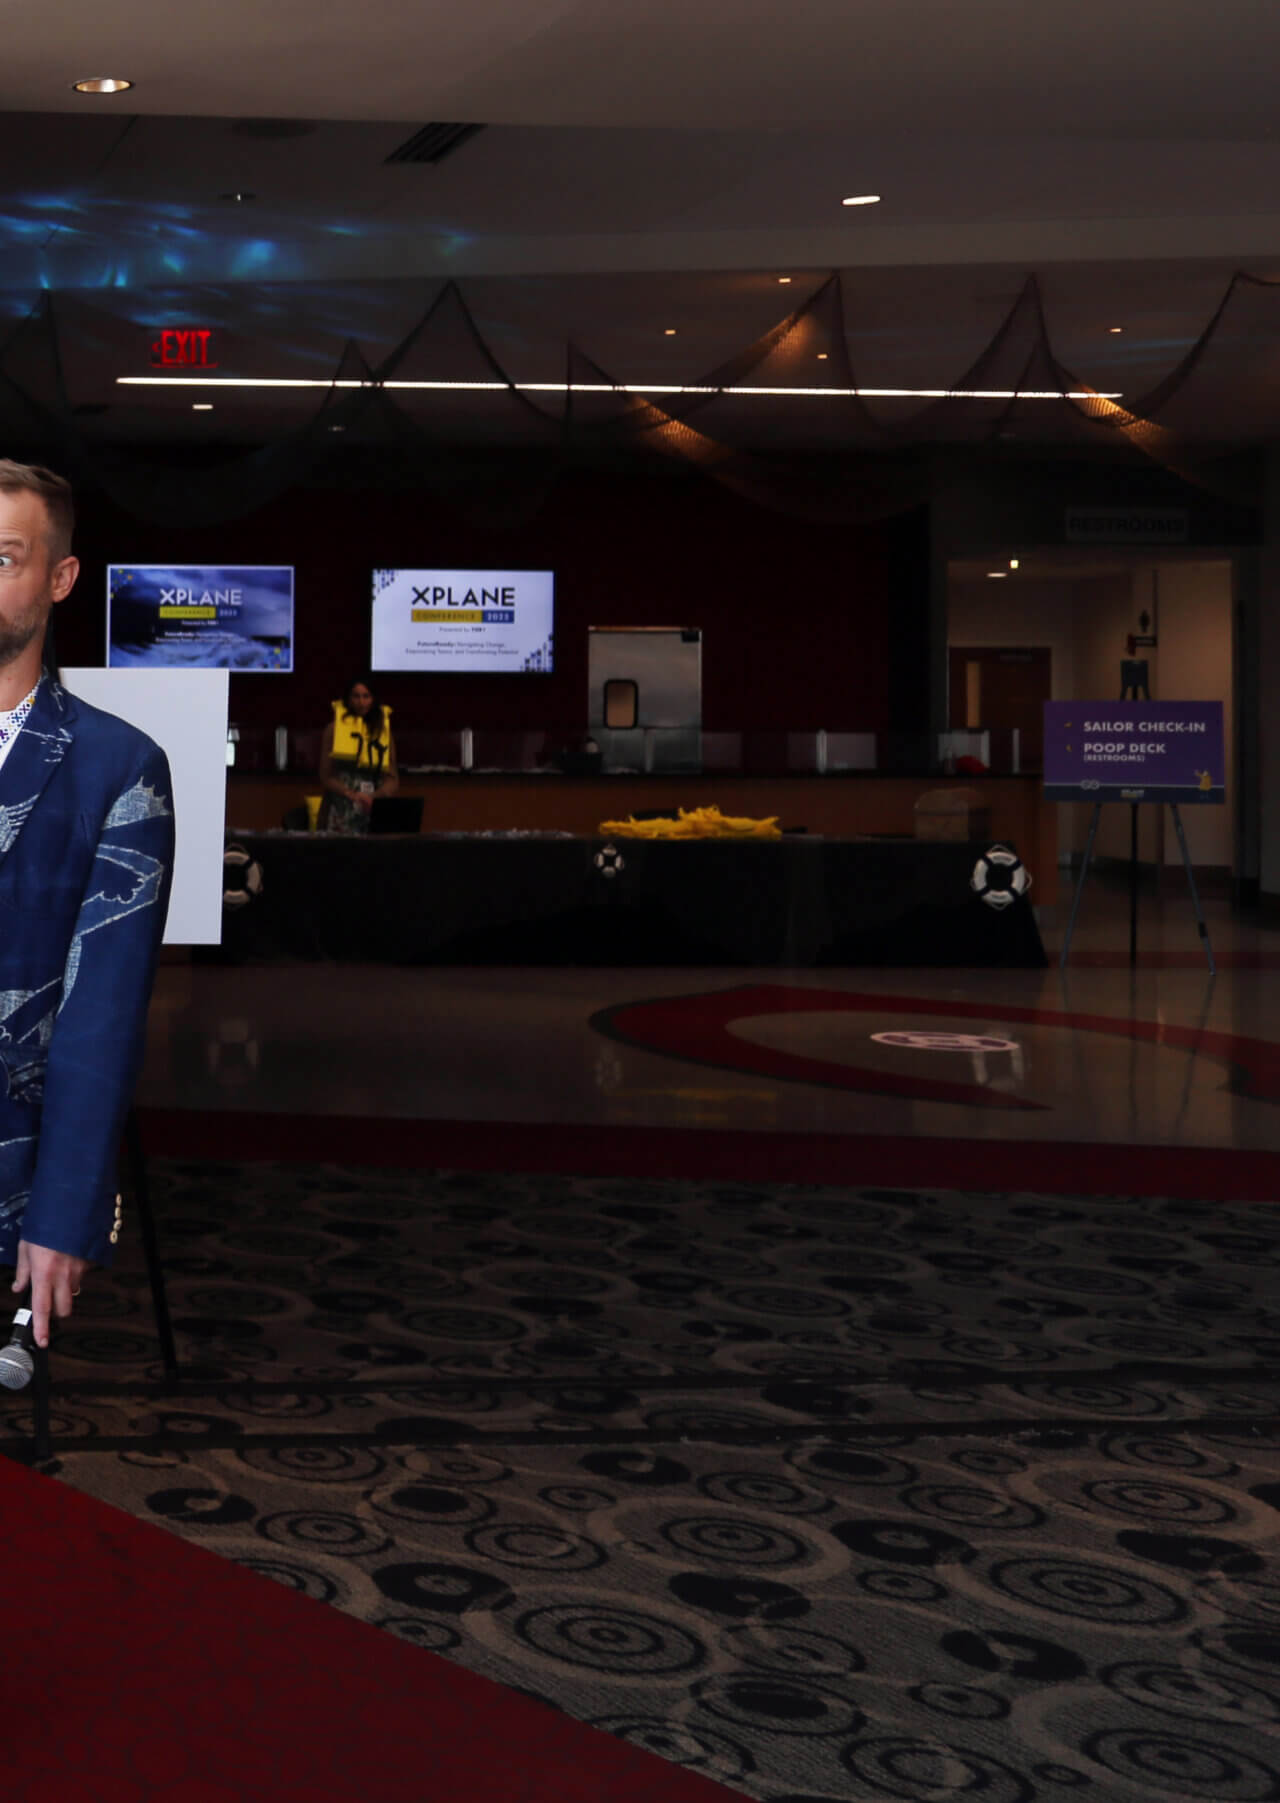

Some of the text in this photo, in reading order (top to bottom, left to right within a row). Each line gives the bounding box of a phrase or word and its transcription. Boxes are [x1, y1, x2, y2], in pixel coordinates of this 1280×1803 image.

[162, 330, 210, 363] EXIT
[160, 588, 243, 606] XPLANE
[411, 586, 515, 607] XPLANE
[1083, 721, 1206, 733] SAILOR CHECK-IN
[1083, 742, 1167, 754] POOP DECK
[1083, 753, 1146, 763] (RESTROOMS)
